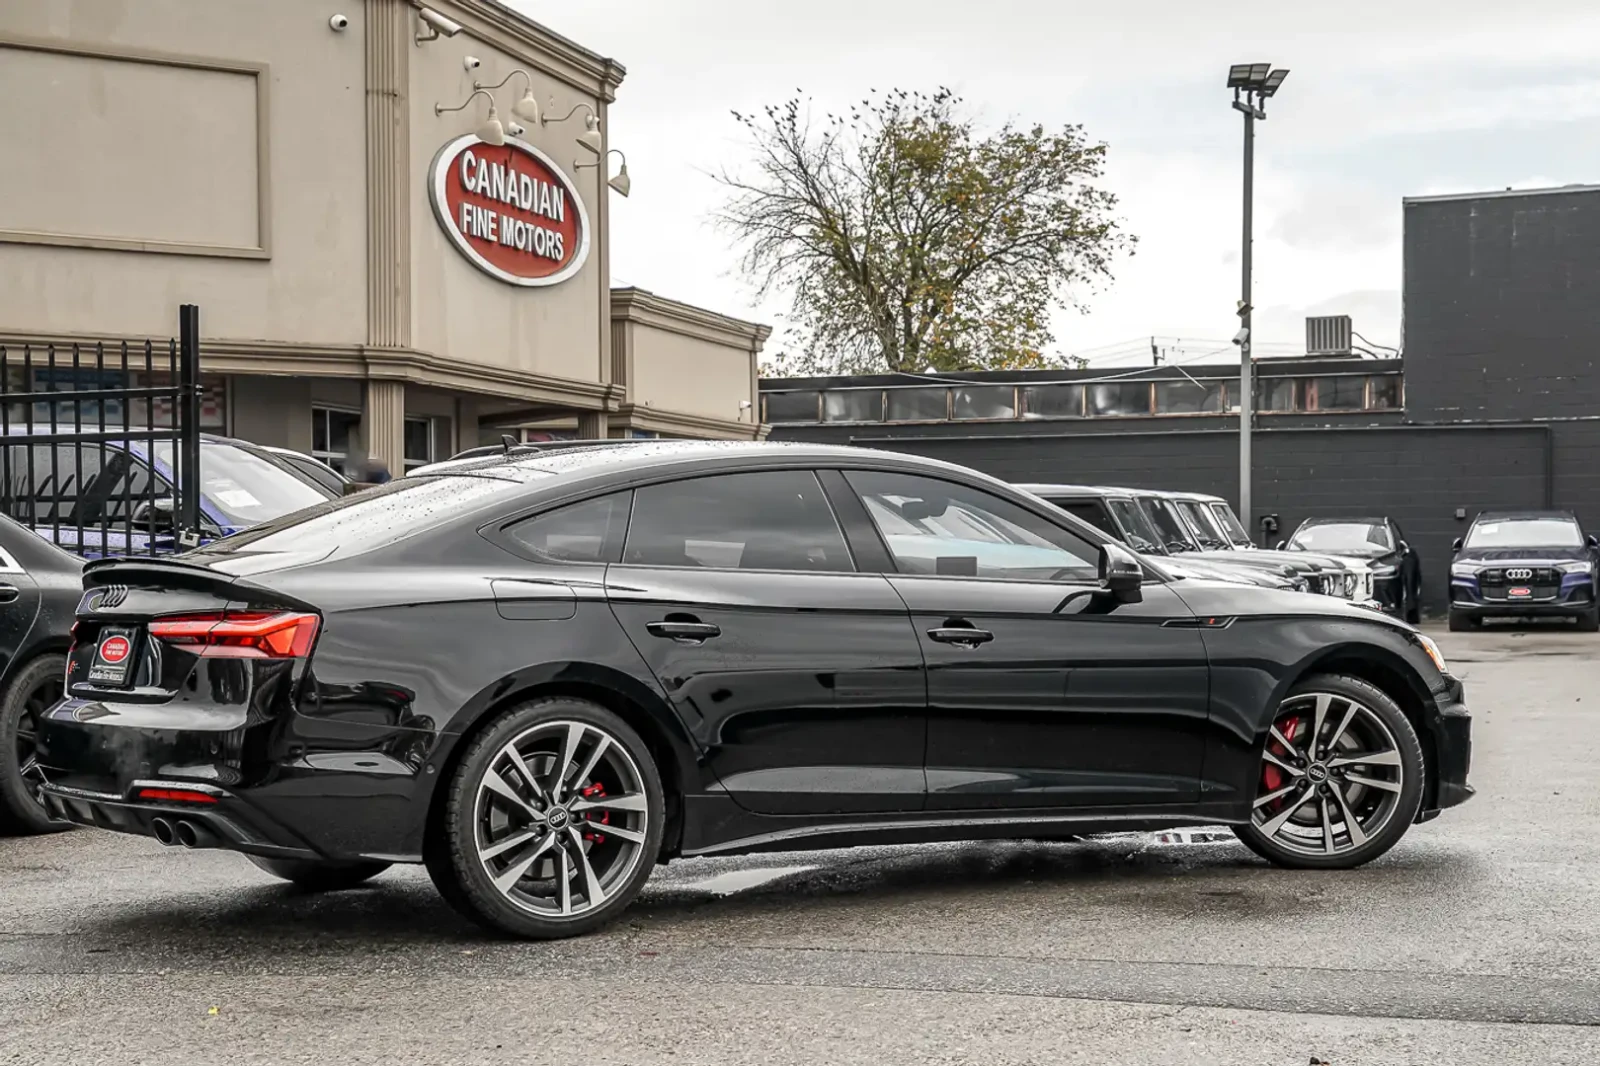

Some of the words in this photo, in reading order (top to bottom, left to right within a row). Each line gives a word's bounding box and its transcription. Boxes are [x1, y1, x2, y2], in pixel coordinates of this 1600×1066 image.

[462, 150, 564, 222] CANADIAN
[462, 203, 497, 242] FINE
[502, 215, 564, 261] MOTORS
